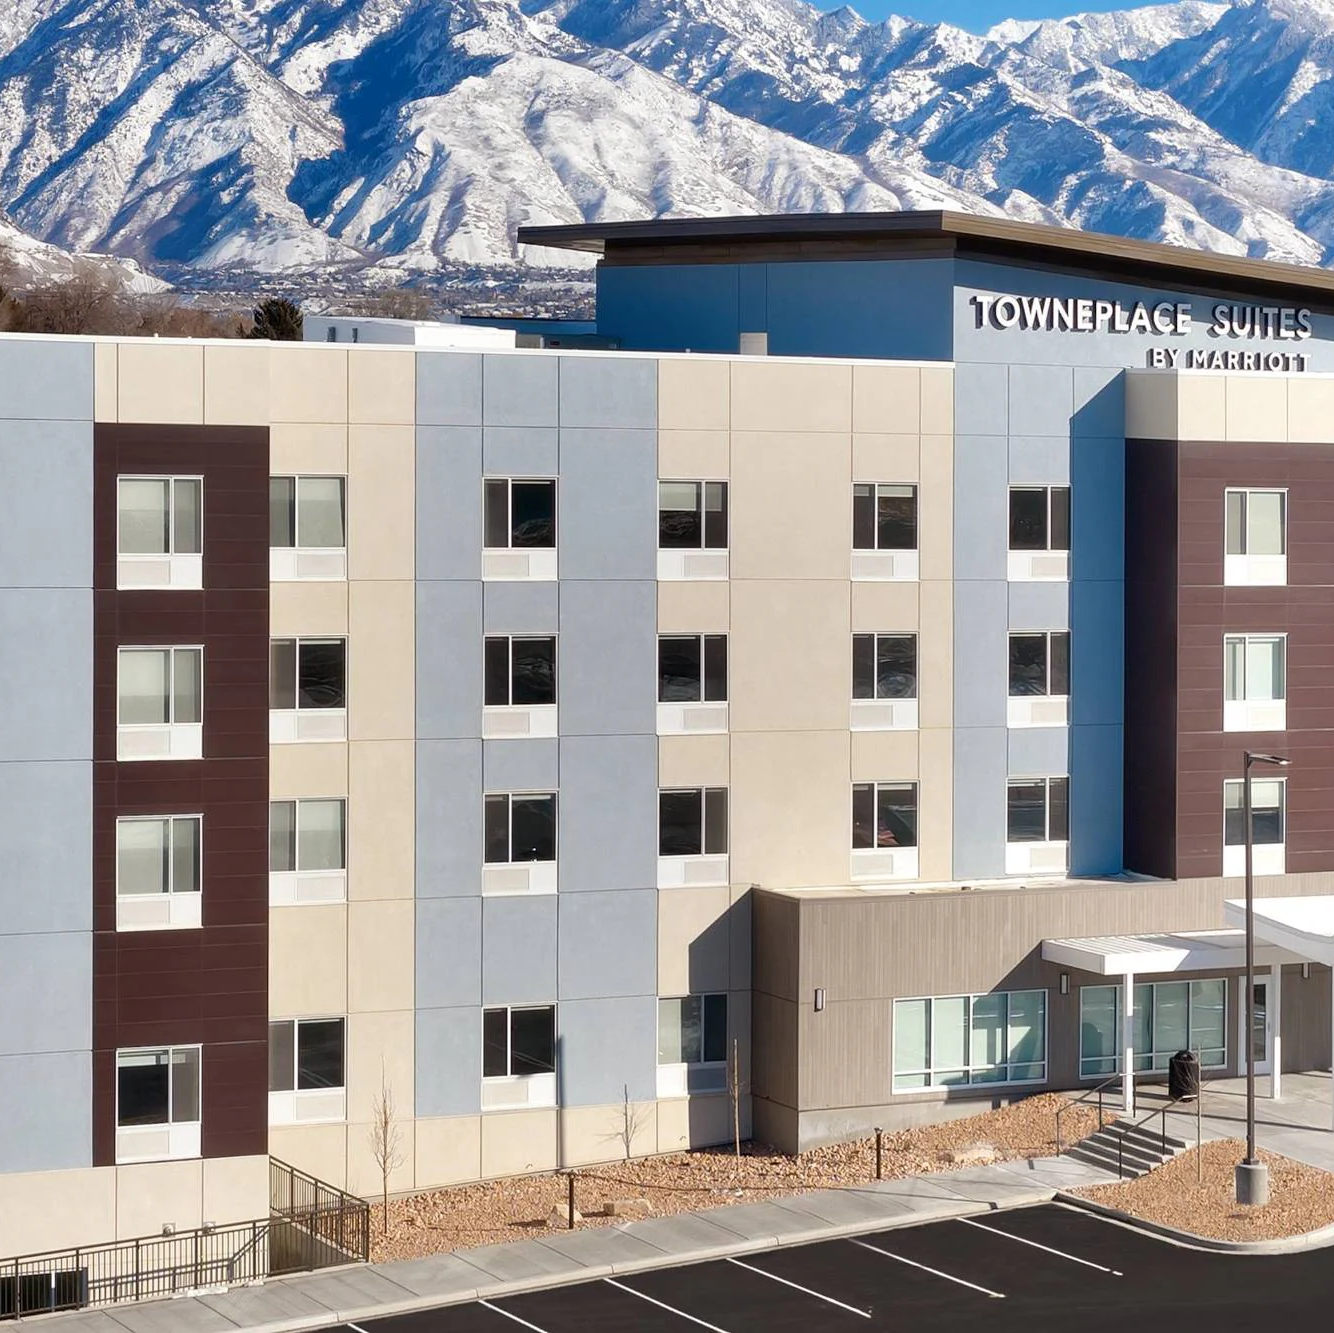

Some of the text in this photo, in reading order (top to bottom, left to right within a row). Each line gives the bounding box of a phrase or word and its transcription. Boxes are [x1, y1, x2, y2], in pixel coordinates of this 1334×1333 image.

[975, 295, 1313, 338] TOWNEPLACE SUITES
[1152, 347, 1312, 372] BY MARRIOTT
